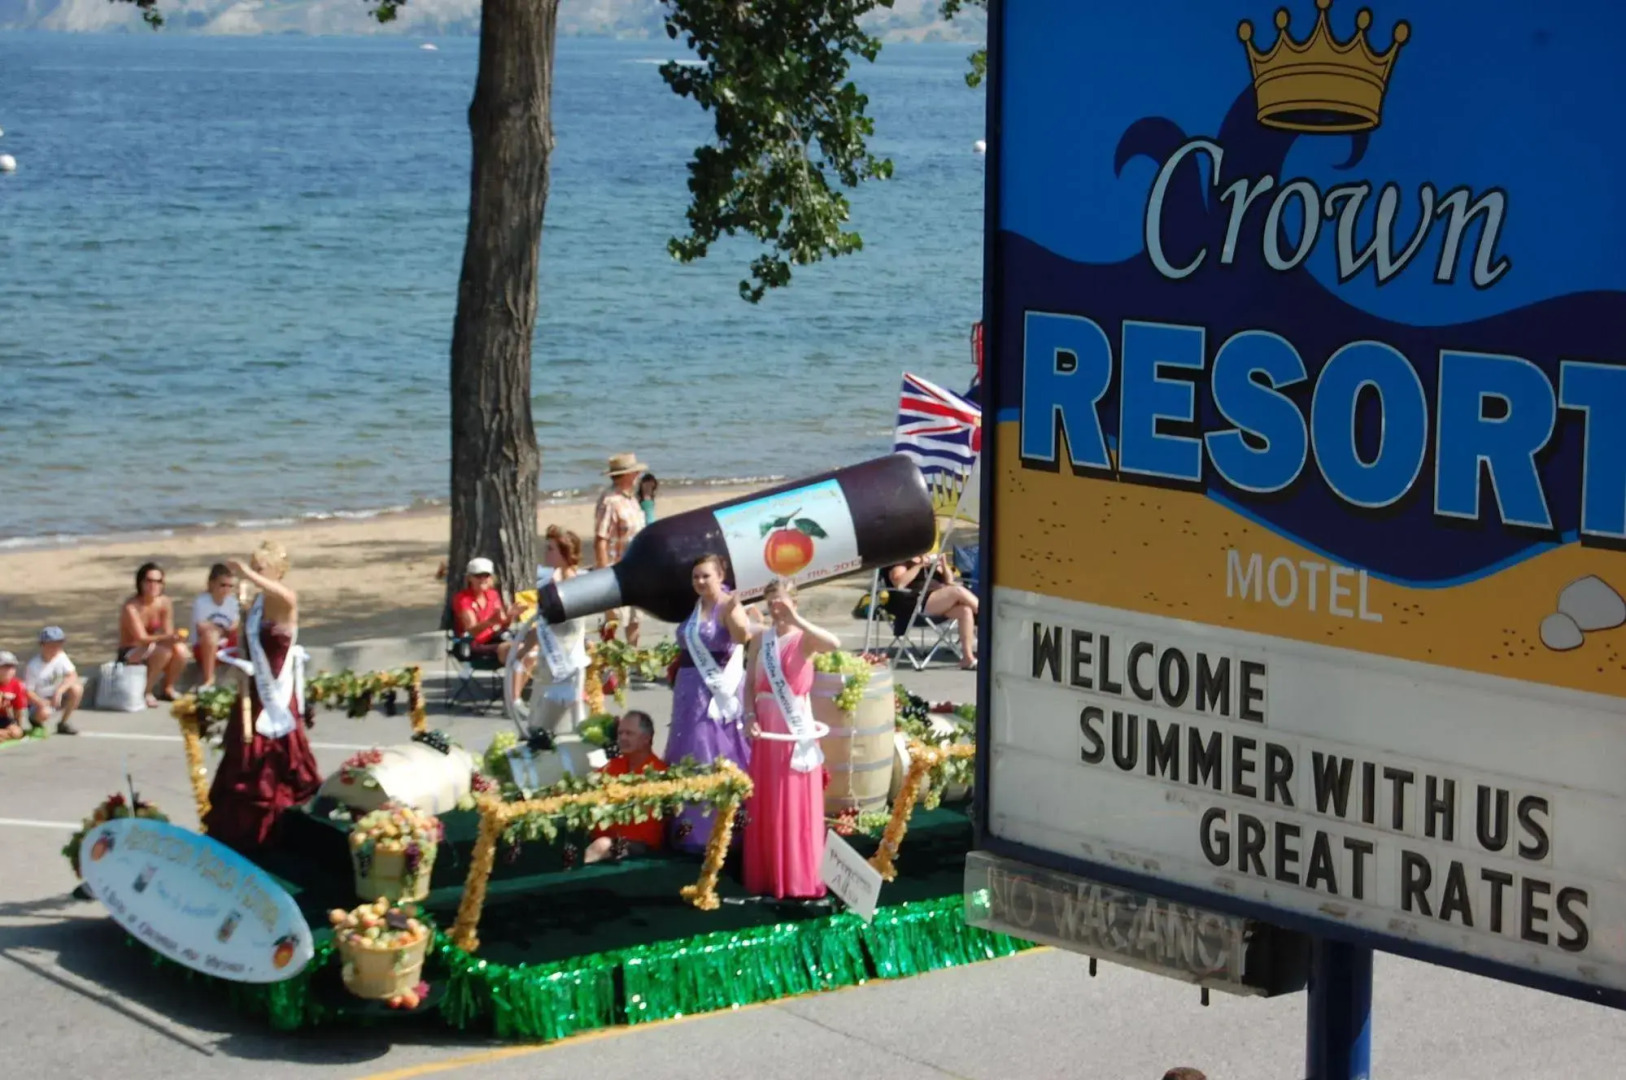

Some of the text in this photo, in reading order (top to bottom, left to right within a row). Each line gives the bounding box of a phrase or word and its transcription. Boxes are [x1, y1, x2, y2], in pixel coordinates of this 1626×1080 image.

[1145, 138, 1509, 287] Crown
[1019, 309, 1626, 541] RESORT
[1226, 549, 1384, 623] MOTEL
[1032, 622, 1267, 723] WELCOME
[1080, 707, 1551, 862] SUMMER WITH US
[1200, 807, 1590, 953] GREAT RATES
